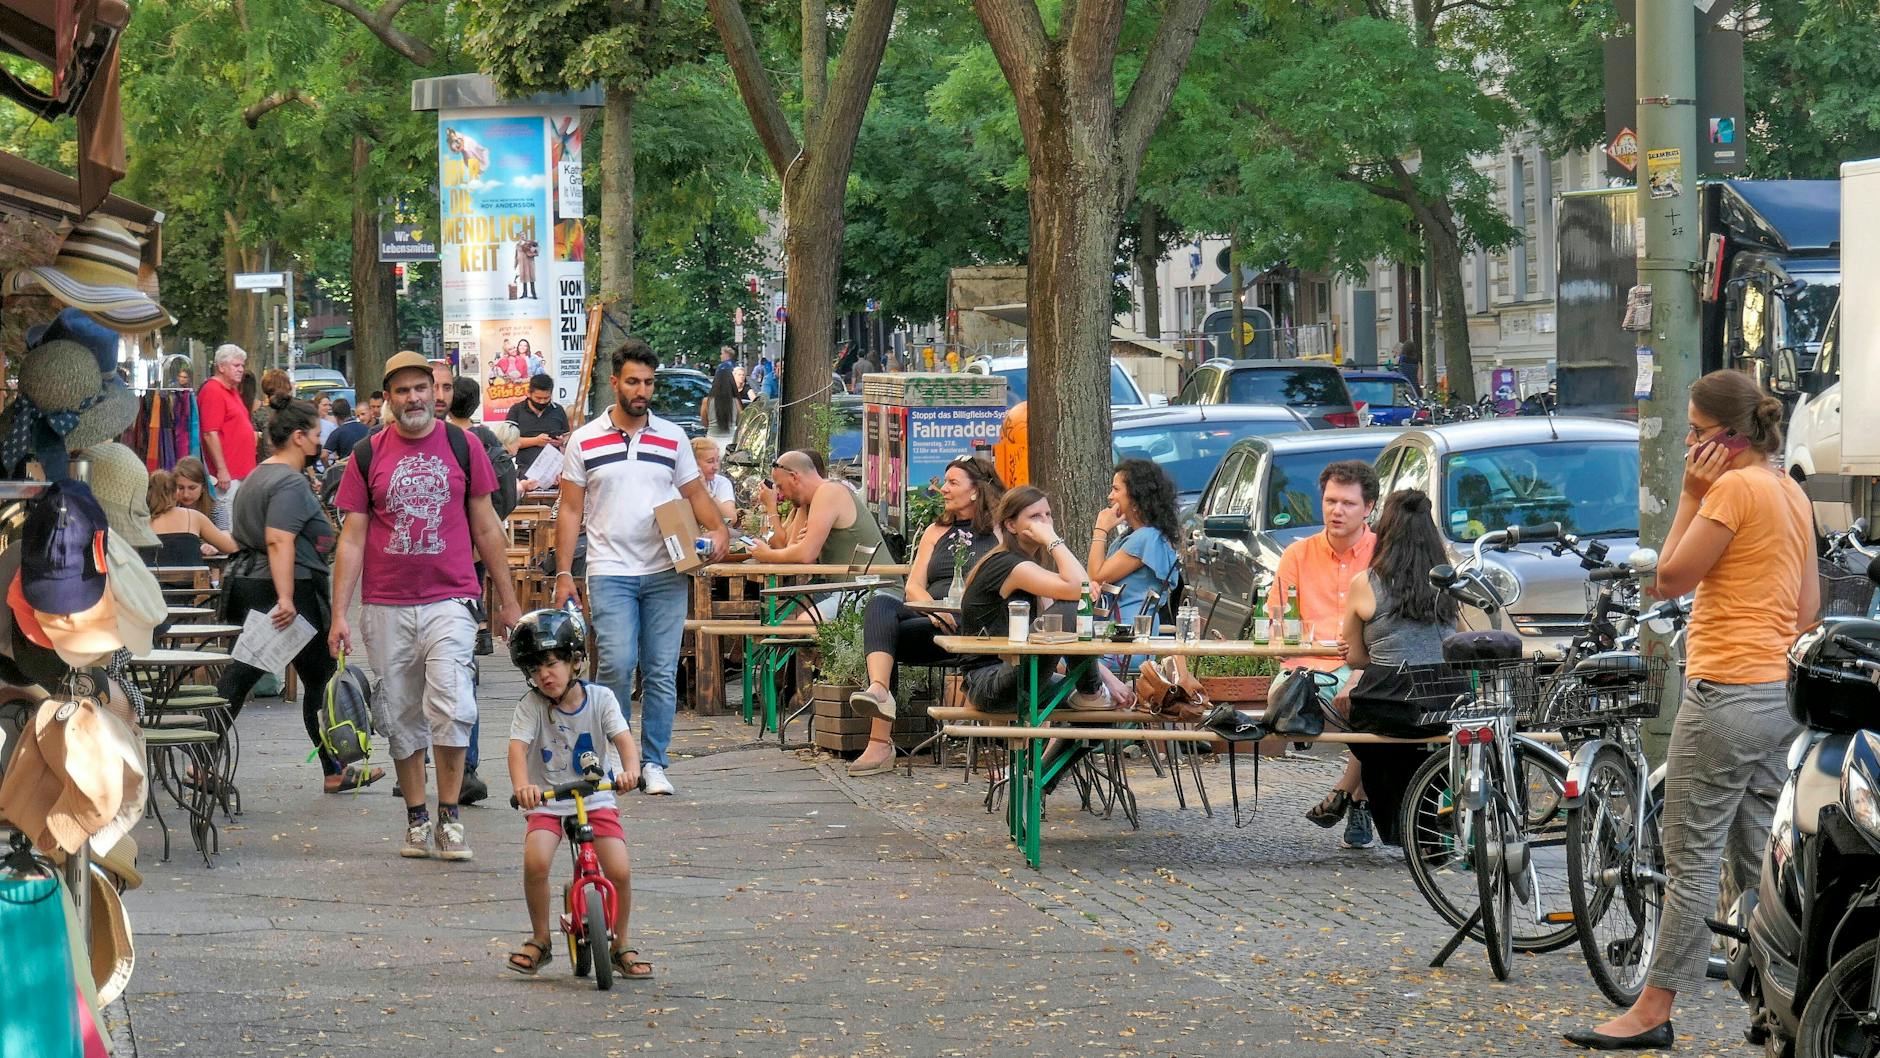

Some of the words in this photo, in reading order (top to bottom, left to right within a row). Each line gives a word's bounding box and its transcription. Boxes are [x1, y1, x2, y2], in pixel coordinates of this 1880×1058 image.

[394, 231, 410, 242] Wir
[460, 244, 499, 272] KEIT
[560, 280, 582, 296] VON
[560, 316, 577, 333] ZU
[489, 384, 513, 398] Bibi
[912, 411, 937, 420] Stoppt
[938, 410, 952, 419] das
